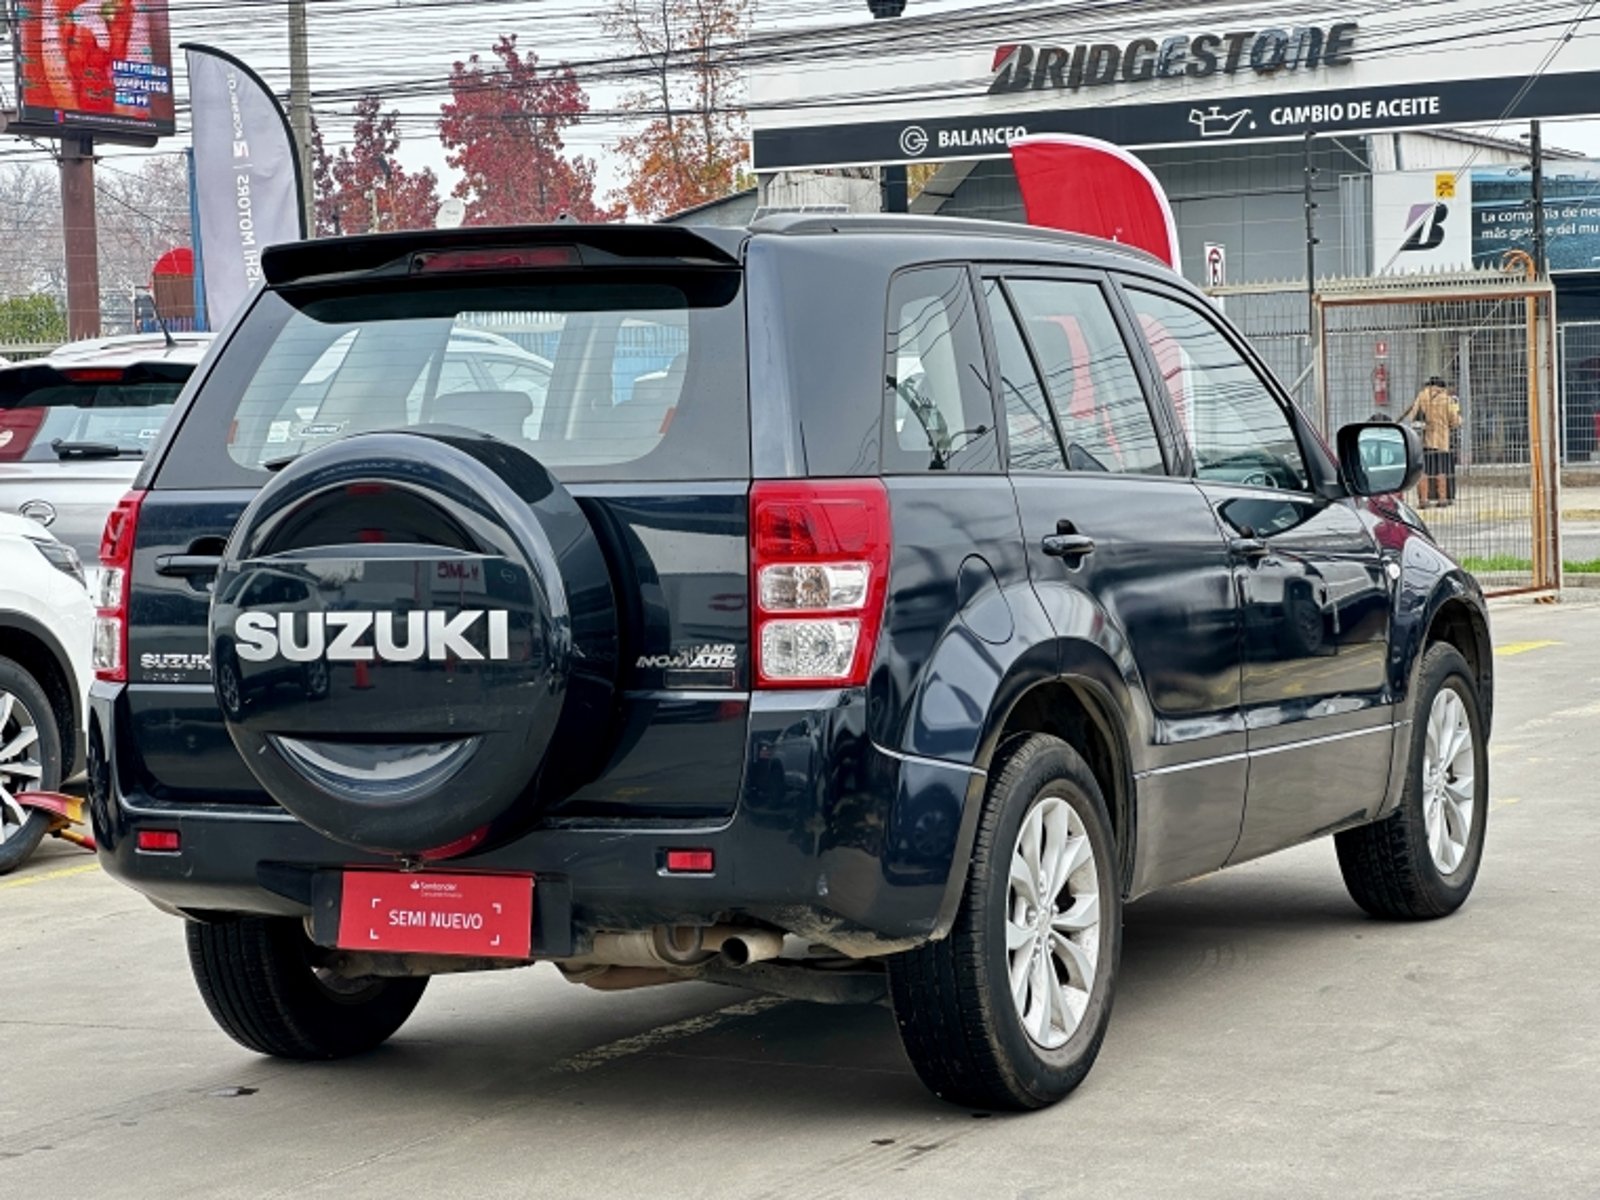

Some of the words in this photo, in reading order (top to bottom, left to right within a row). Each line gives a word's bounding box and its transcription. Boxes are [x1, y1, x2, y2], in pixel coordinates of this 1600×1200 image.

[987, 22, 1358, 95] BRIDGESTONE
[1270, 103, 1344, 125] CAMBIO
[1347, 100, 1372, 120] DE
[1375, 96, 1440, 118] ACEITE
[1482, 211, 1496, 224] La
[1561, 205, 1578, 218] de
[1556, 222, 1576, 235] del
[234, 609, 509, 662] SUZUKI
[141, 651, 211, 671] SUZUK
[388, 910, 426, 928] SEMI
[430, 912, 483, 930] NUEVO
